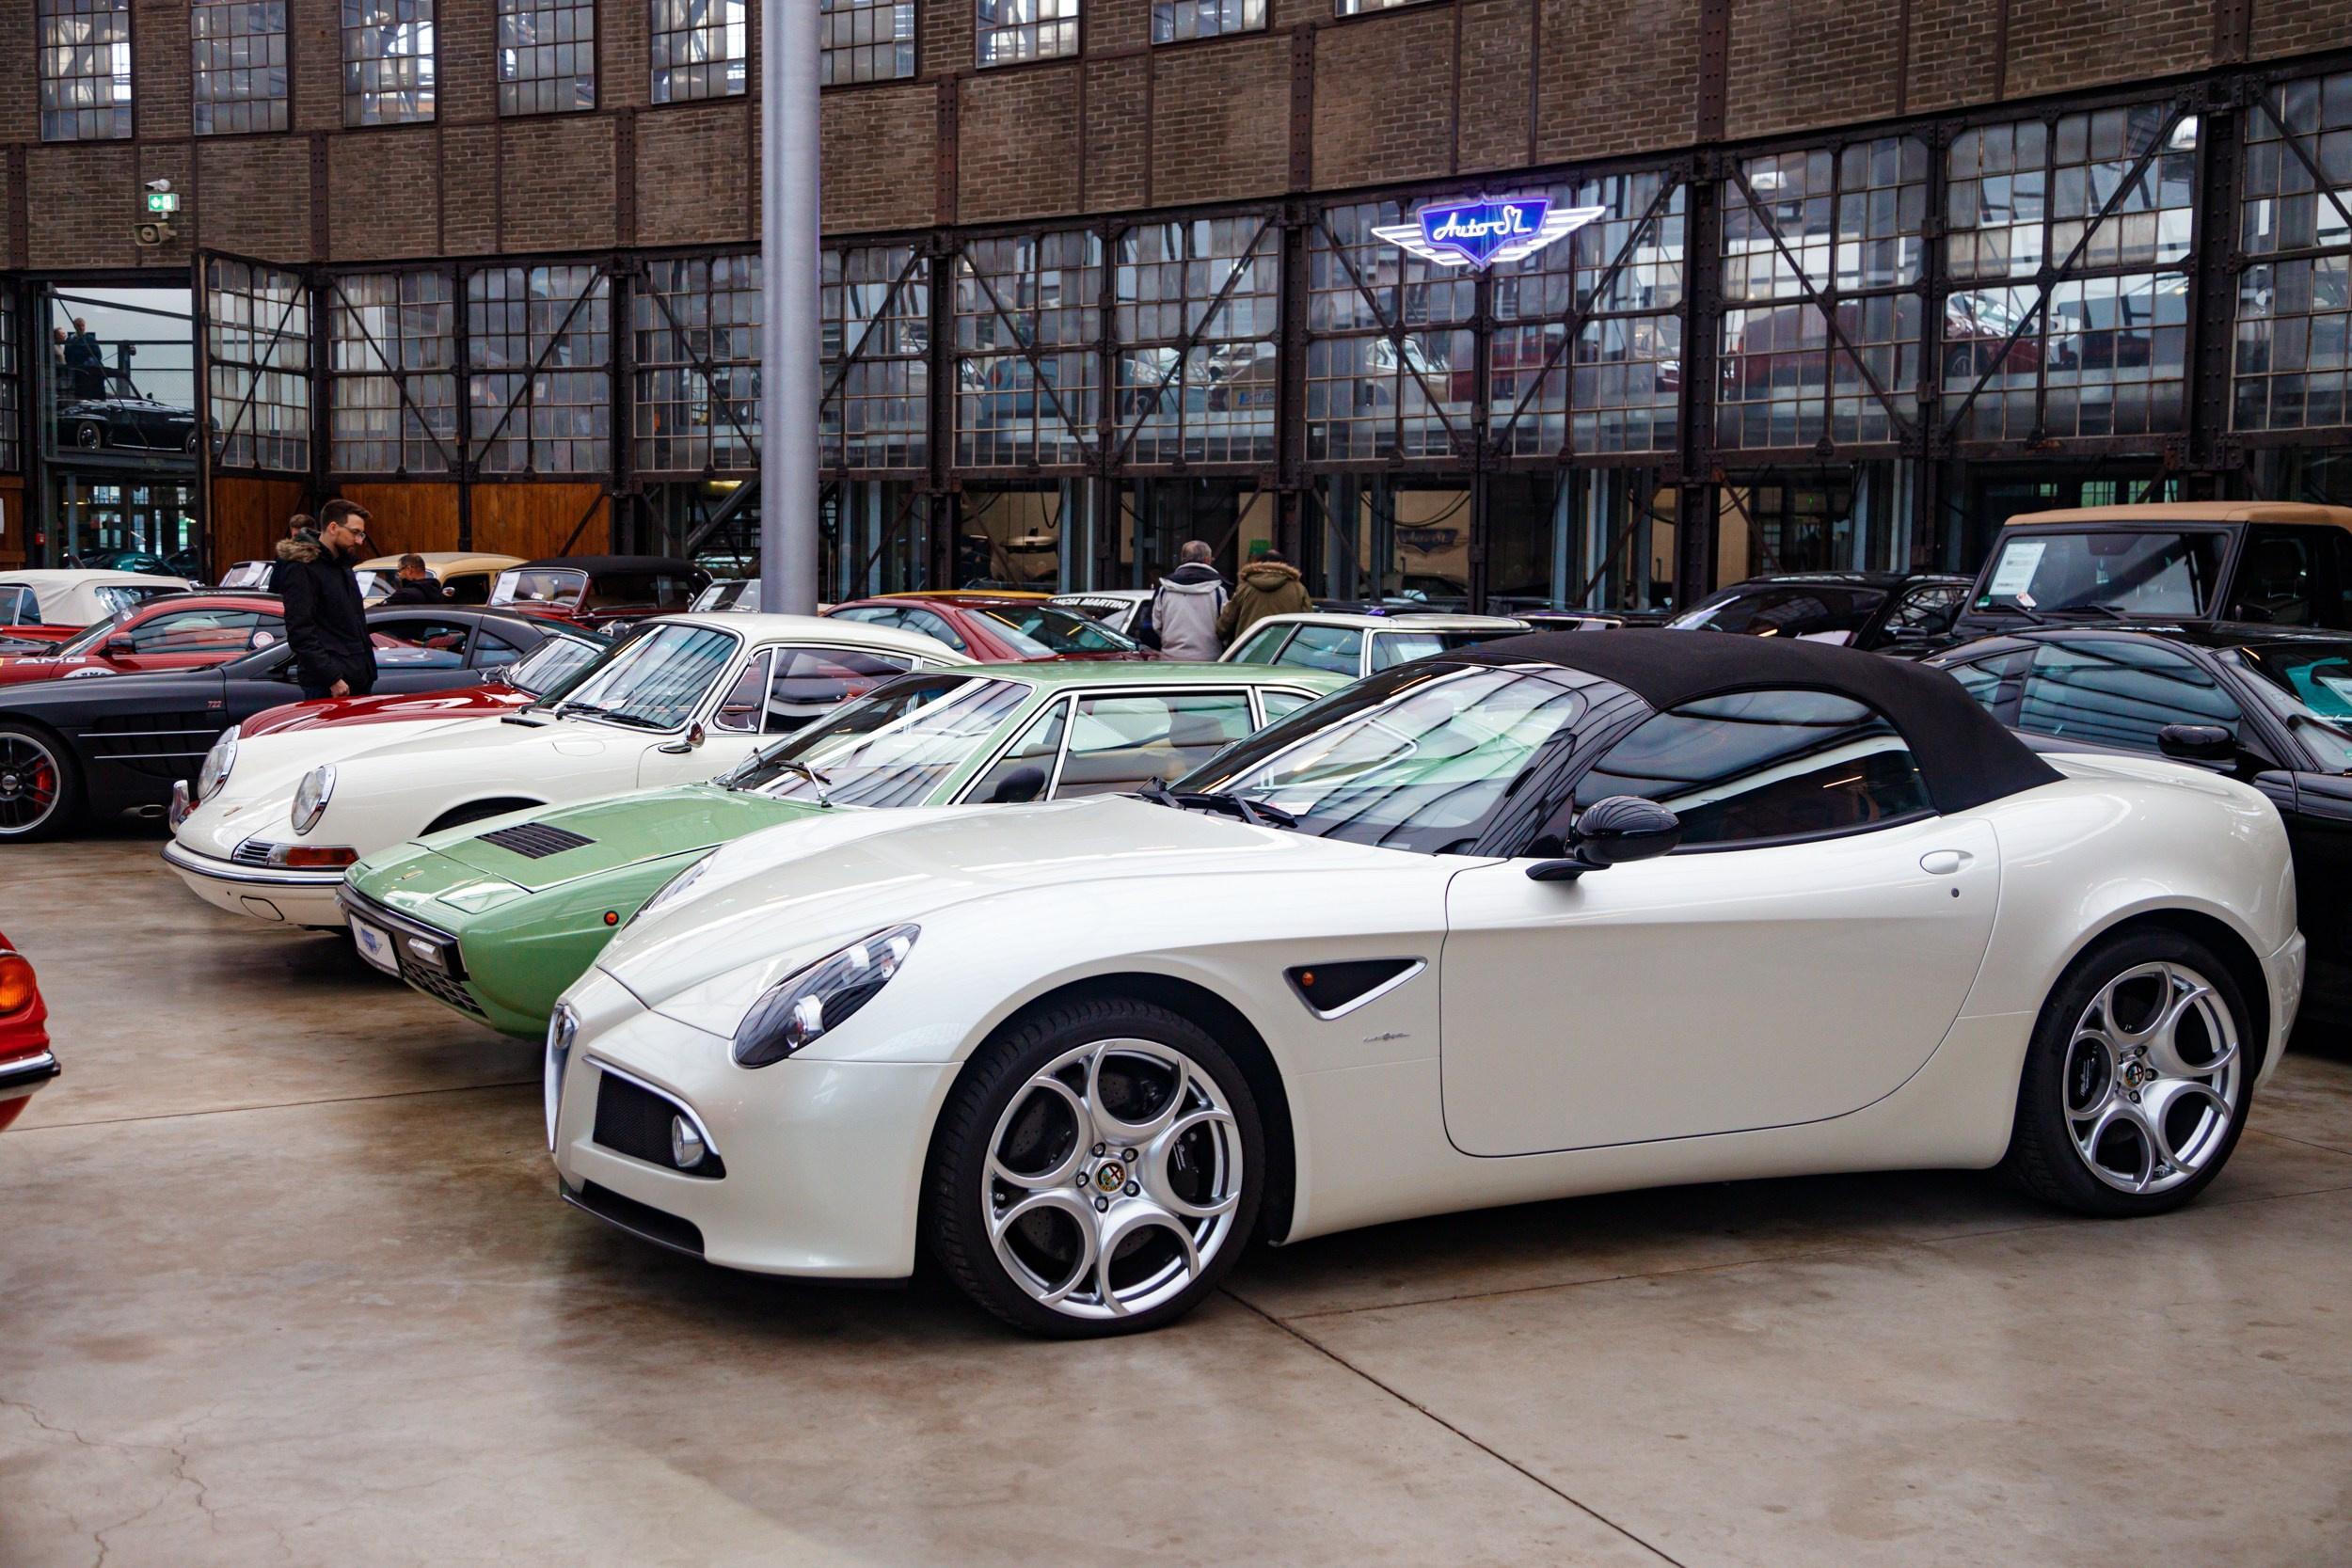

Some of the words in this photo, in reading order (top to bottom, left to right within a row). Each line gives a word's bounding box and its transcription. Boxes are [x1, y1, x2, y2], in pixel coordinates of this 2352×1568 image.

[1433, 212, 1487, 241] Auto
[1080, 597, 1131, 610] MARTINI
[208, 700, 222, 708] 722
